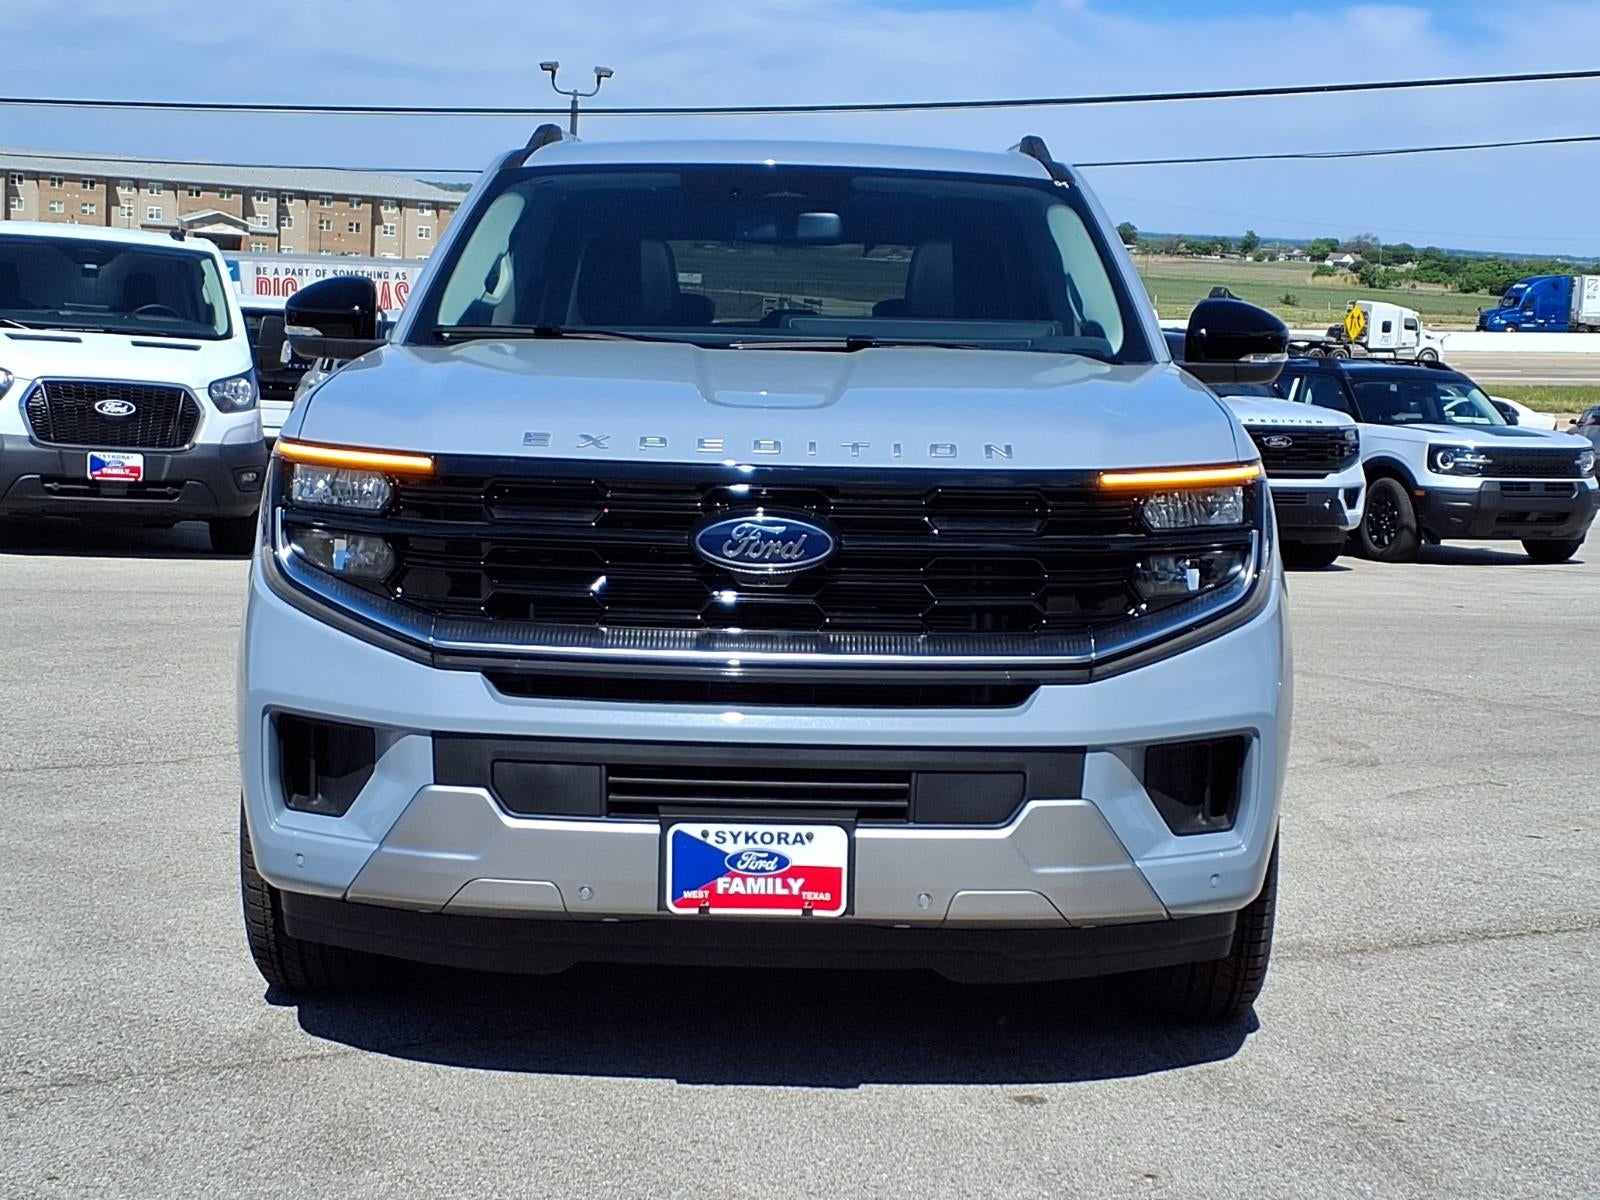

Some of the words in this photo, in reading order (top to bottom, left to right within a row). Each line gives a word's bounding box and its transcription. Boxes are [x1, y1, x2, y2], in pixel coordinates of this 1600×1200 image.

[256, 266, 267, 275] BE
[273, 267, 279, 276] A
[285, 267, 310, 277] PART
[315, 268, 327, 278] OF
[395, 271, 408, 281] AS
[102, 401, 129, 413] Ford
[522, 430, 1014, 460] EXPEDITION
[722, 522, 808, 559] Ford
[714, 830, 806, 846] SYKORA
[736, 851, 778, 872] Ford
[716, 877, 806, 895] FAMILY
[683, 889, 710, 899] WEST
[801, 891, 832, 901] TEXAS
